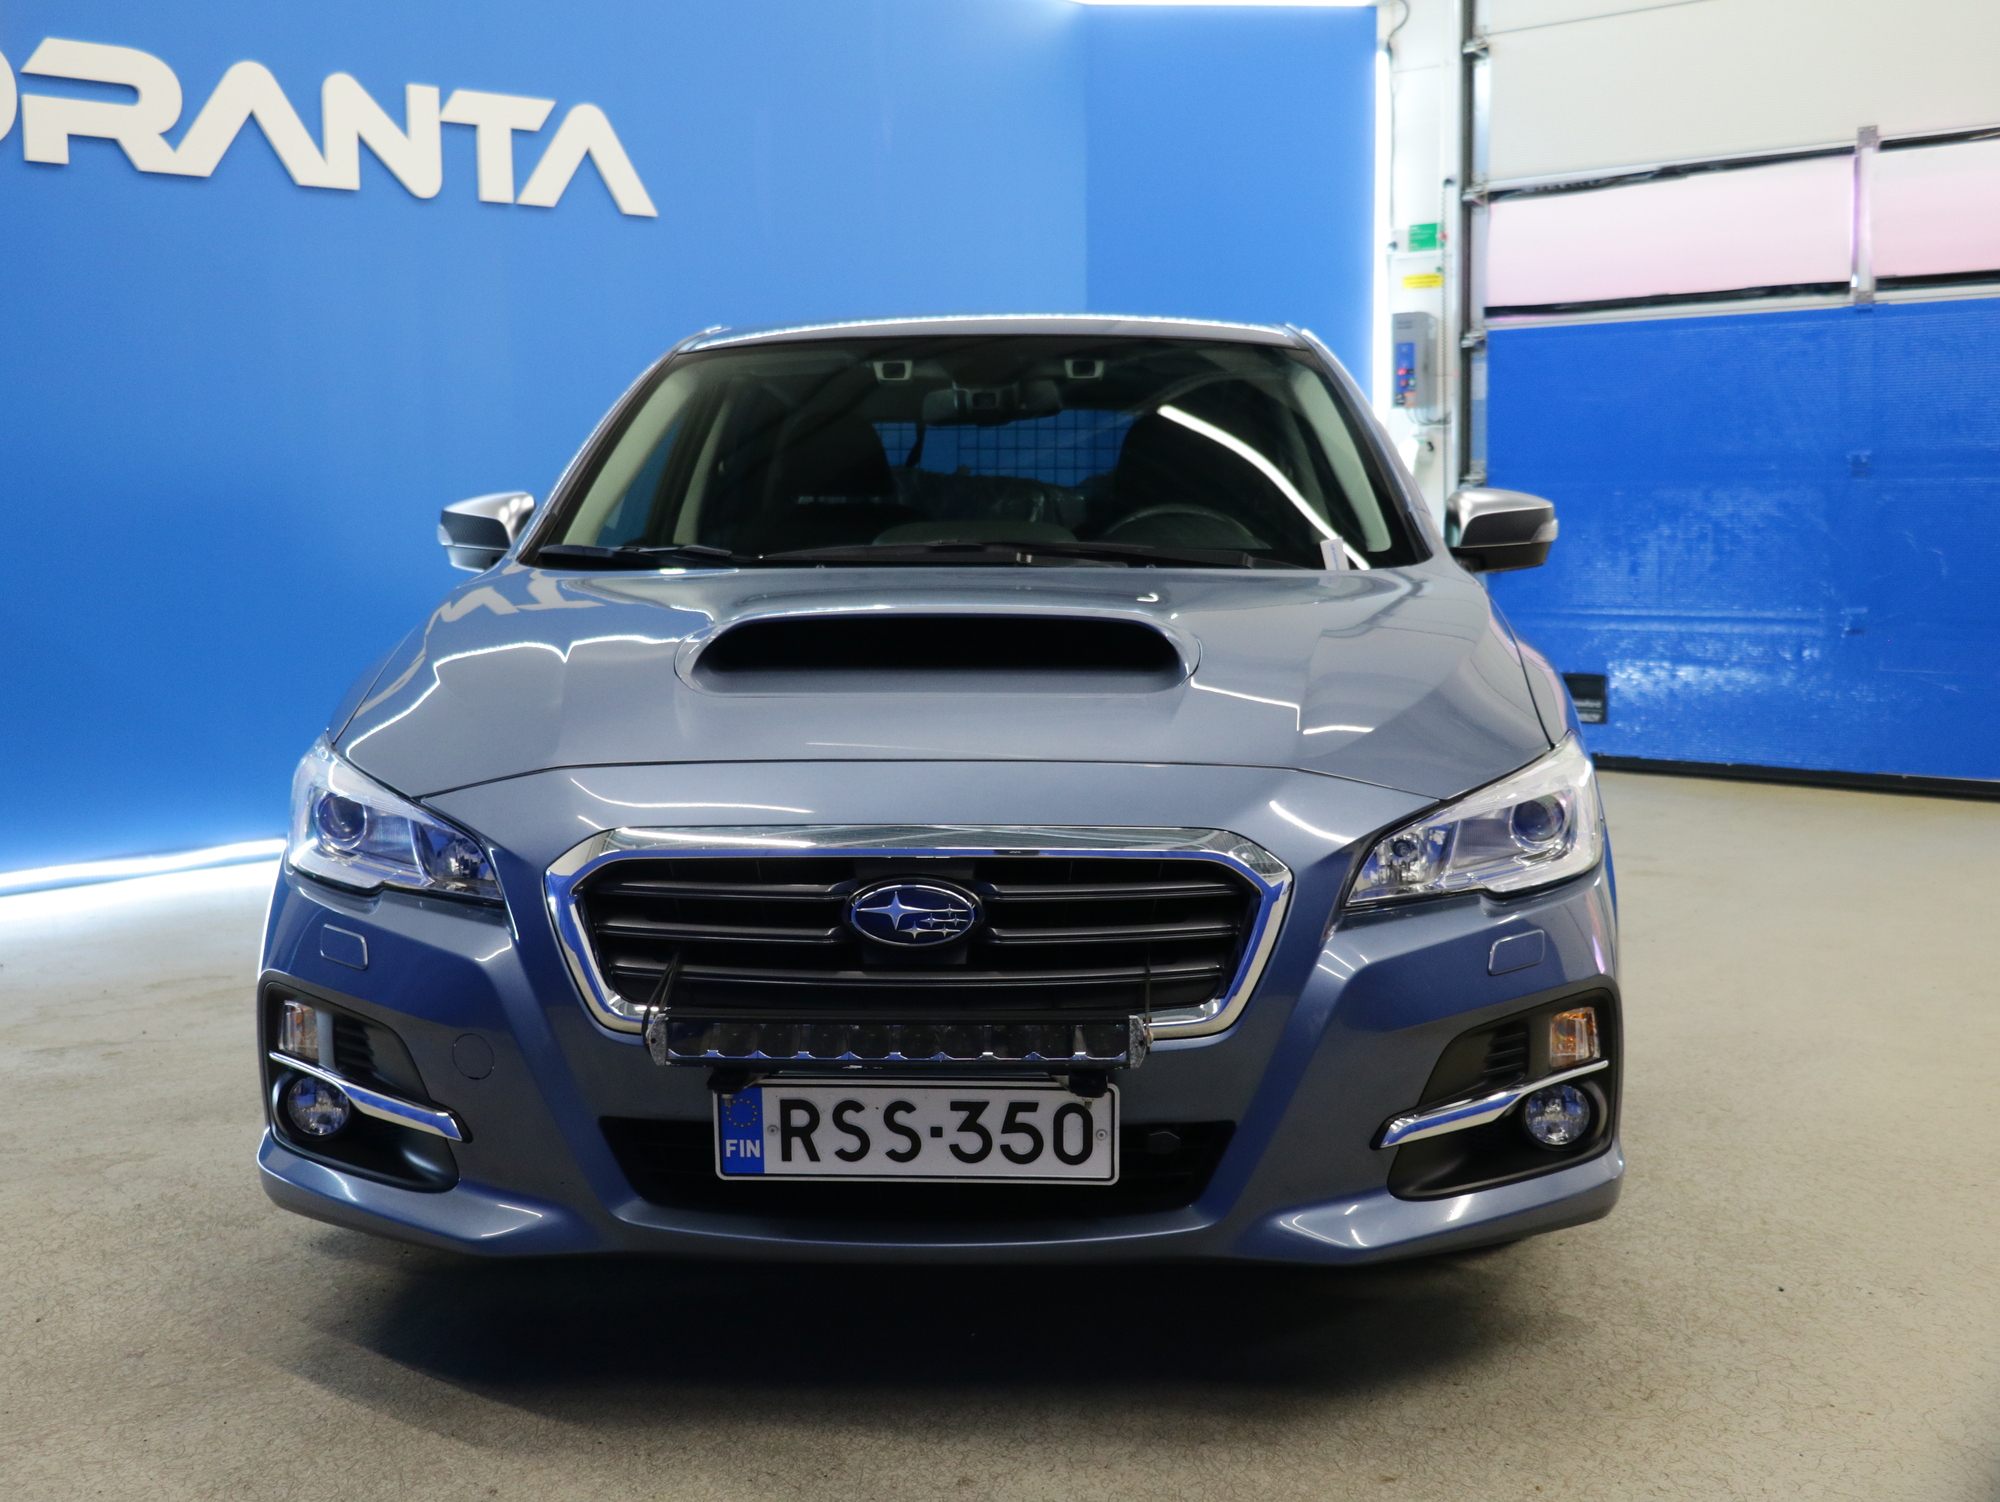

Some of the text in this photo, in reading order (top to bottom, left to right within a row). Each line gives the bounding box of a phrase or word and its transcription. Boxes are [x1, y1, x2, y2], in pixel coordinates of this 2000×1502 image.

[0, 37, 658, 217] RANTA
[726, 1139, 761, 1158] FIN
[779, 1099, 1094, 1165] RSS-350
